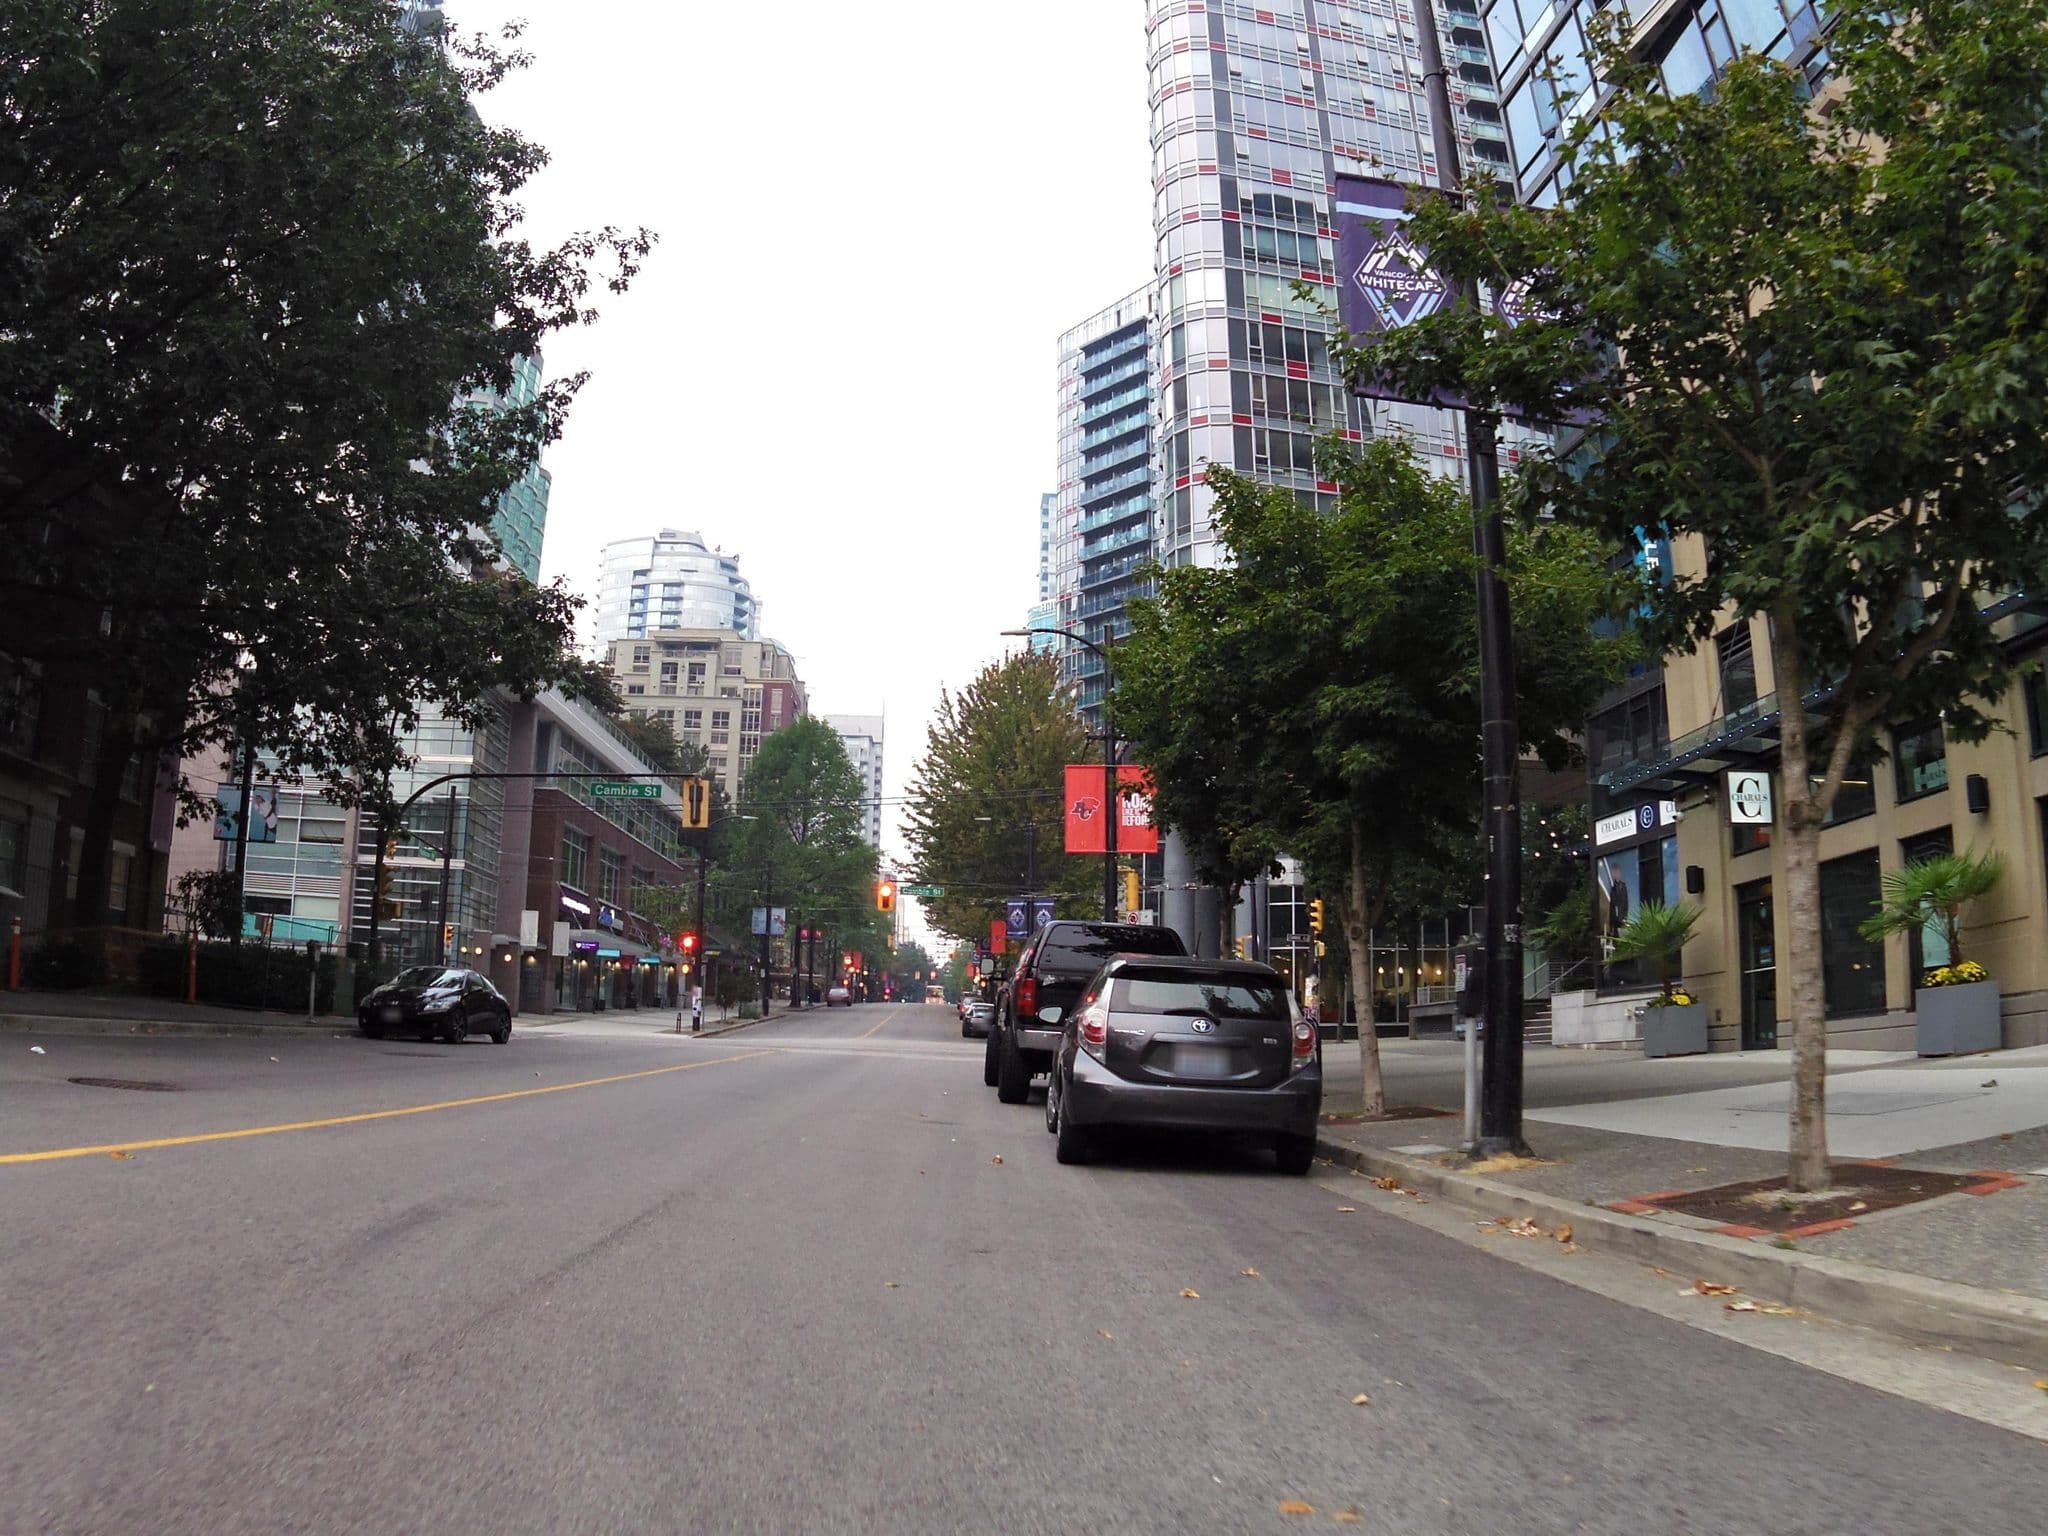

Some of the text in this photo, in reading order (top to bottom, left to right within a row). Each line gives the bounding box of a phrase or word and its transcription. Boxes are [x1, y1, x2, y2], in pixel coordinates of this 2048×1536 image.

[1374, 268, 1427, 280] VANCO
[595, 785, 657, 796] Cambie St
